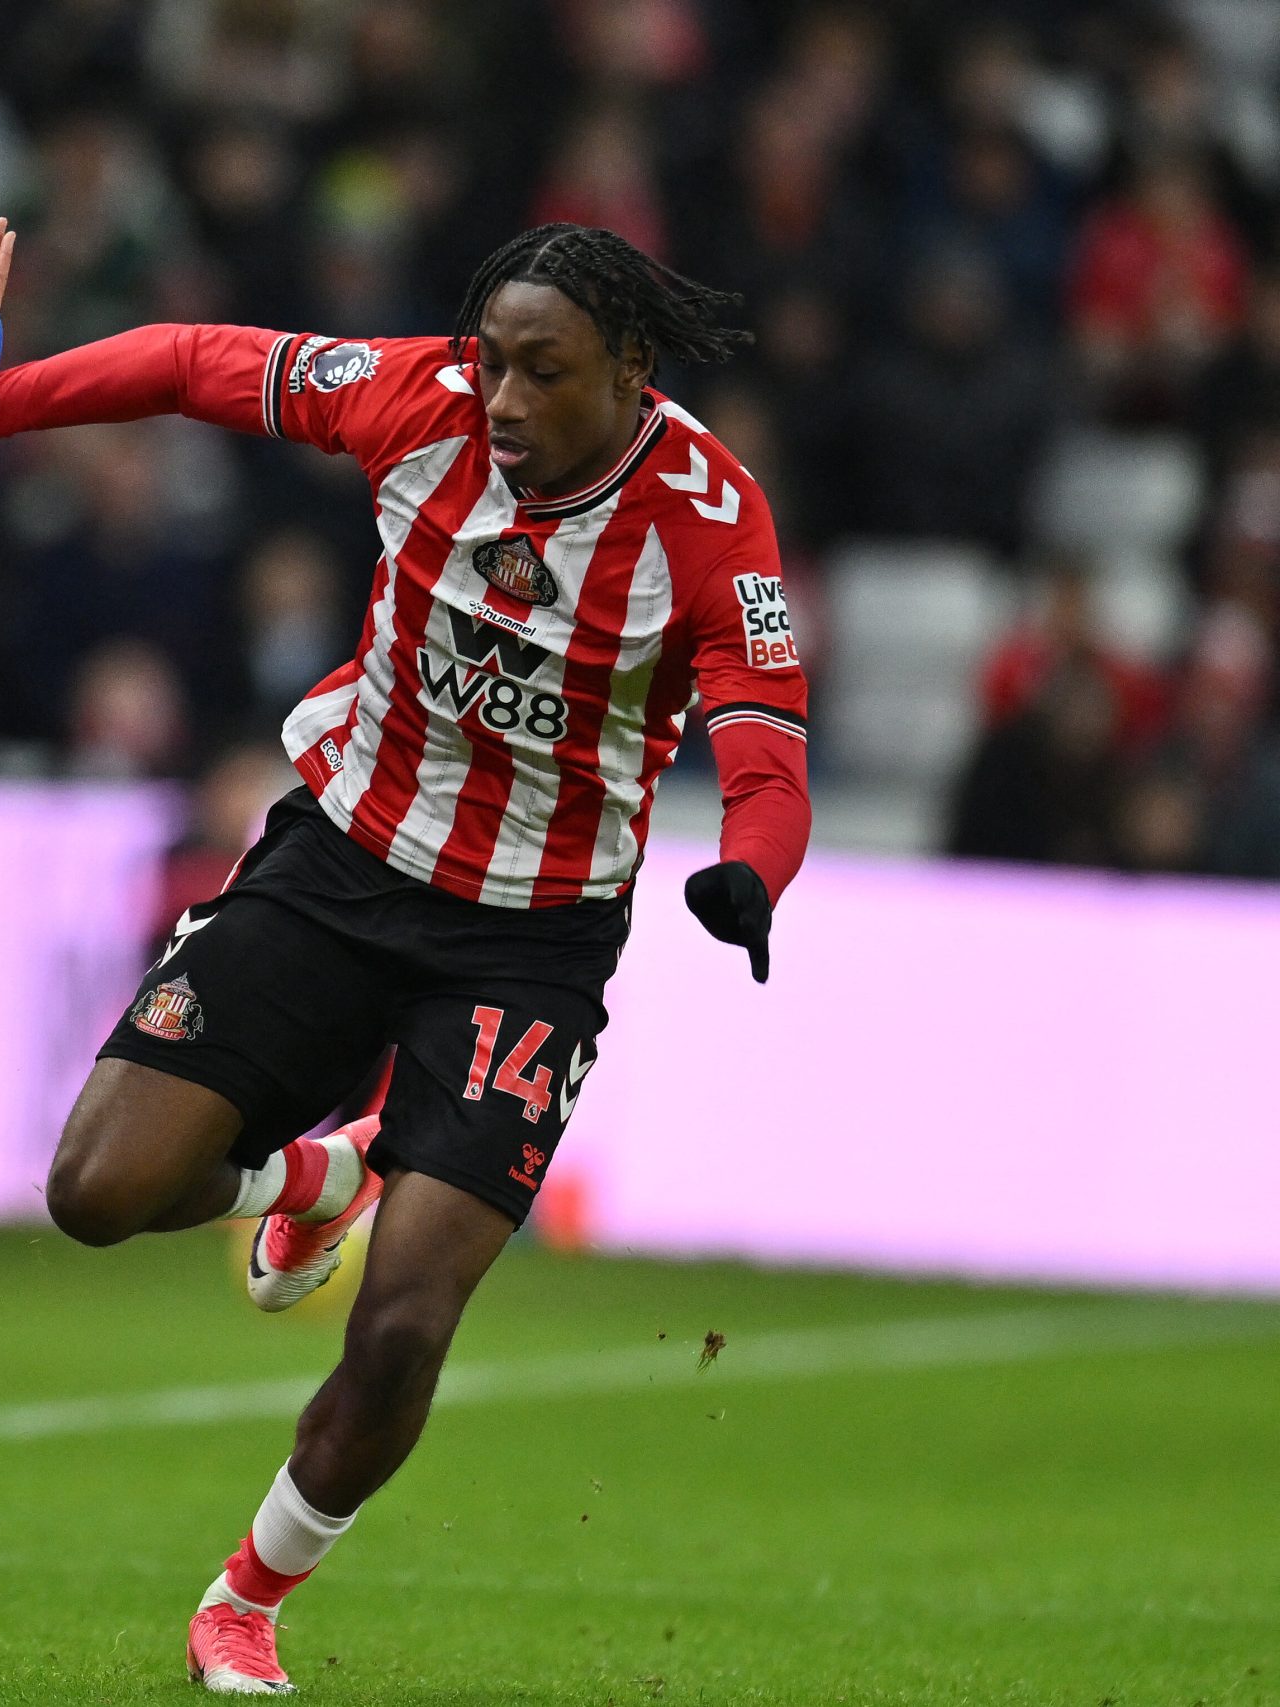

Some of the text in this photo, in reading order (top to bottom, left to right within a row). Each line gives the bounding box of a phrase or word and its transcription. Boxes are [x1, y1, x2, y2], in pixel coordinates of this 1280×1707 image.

[483, 607, 537, 637] hummel
[750, 634, 799, 667] Bet
[419, 649, 566, 739] W88
[322, 740, 343, 770] ECO8
[463, 1005, 554, 1124] 14
